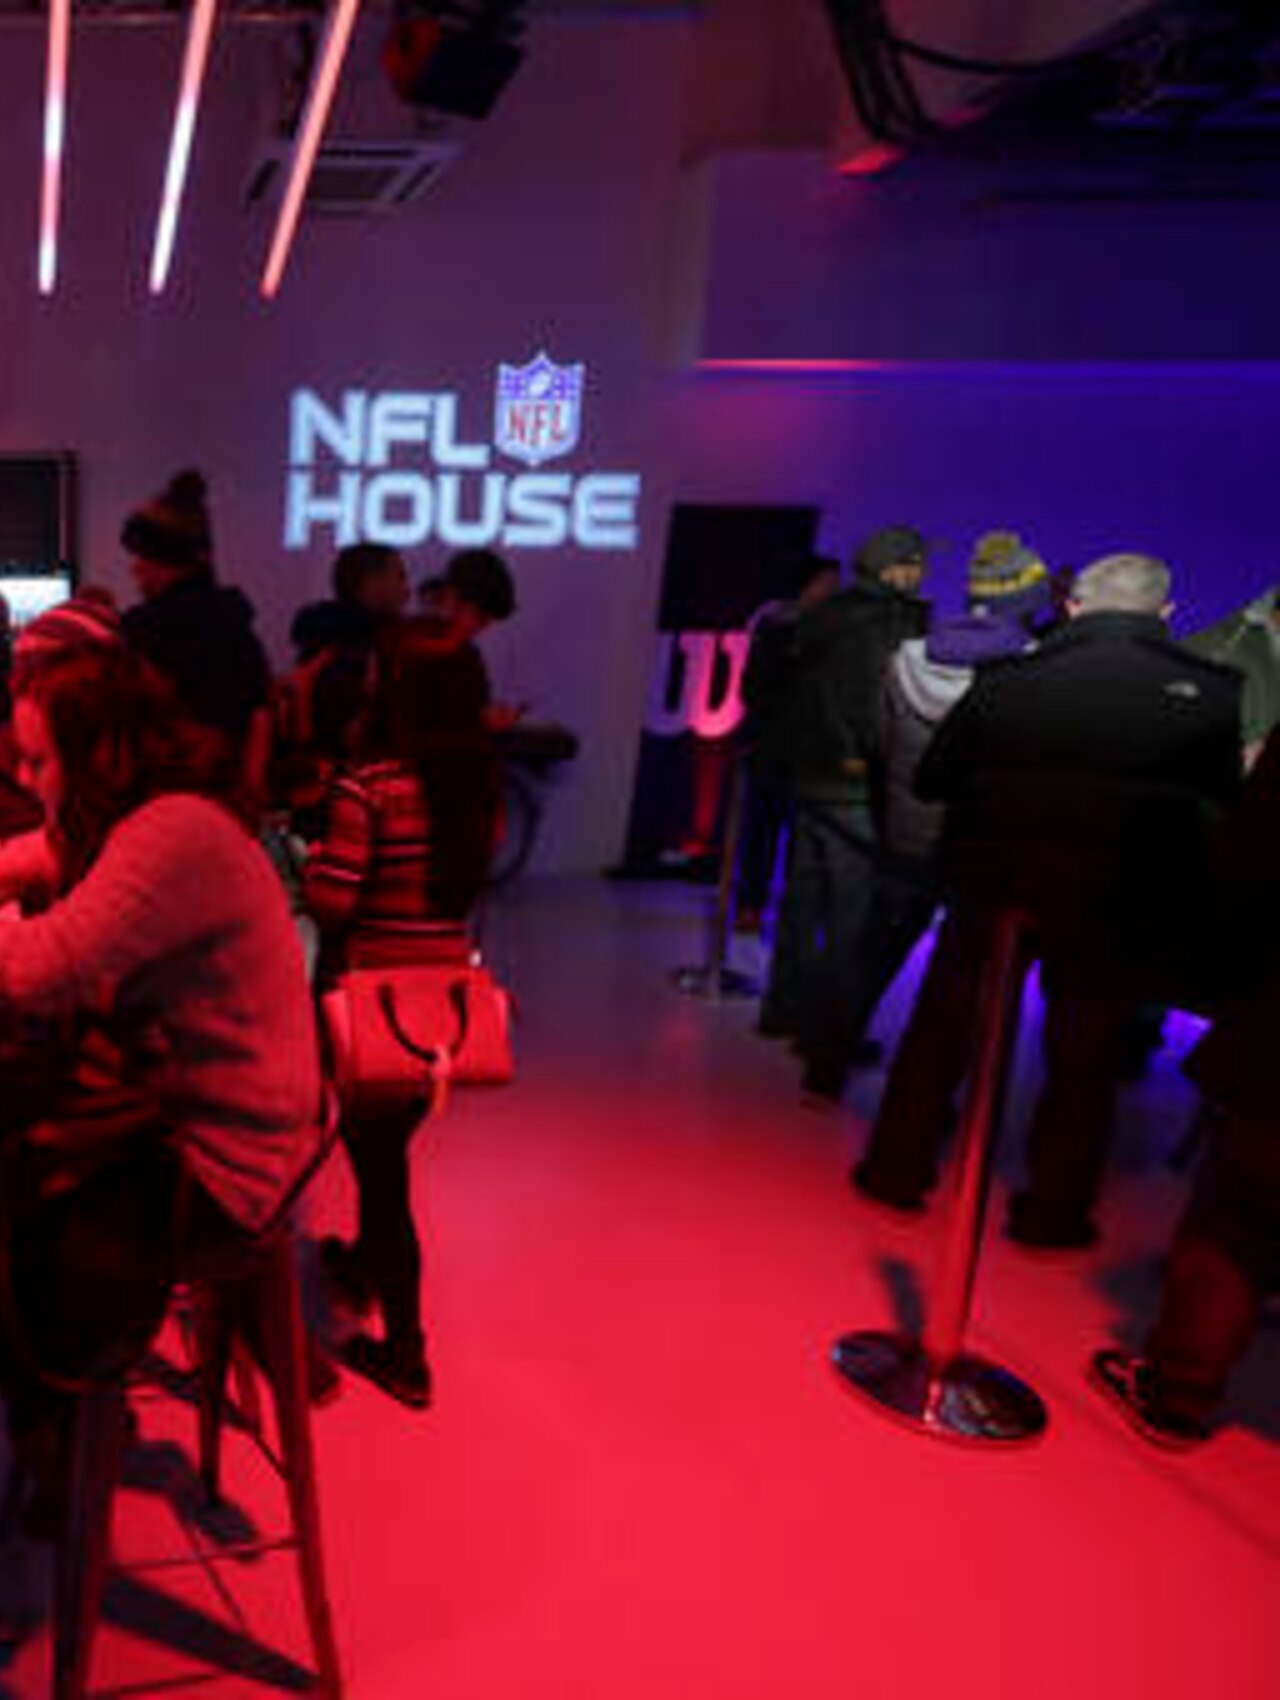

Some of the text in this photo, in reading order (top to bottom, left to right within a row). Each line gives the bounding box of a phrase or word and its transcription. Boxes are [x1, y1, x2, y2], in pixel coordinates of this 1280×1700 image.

[288, 388, 491, 468] NFL
[508, 402, 568, 446] NFL
[283, 472, 641, 549] HOUSE
